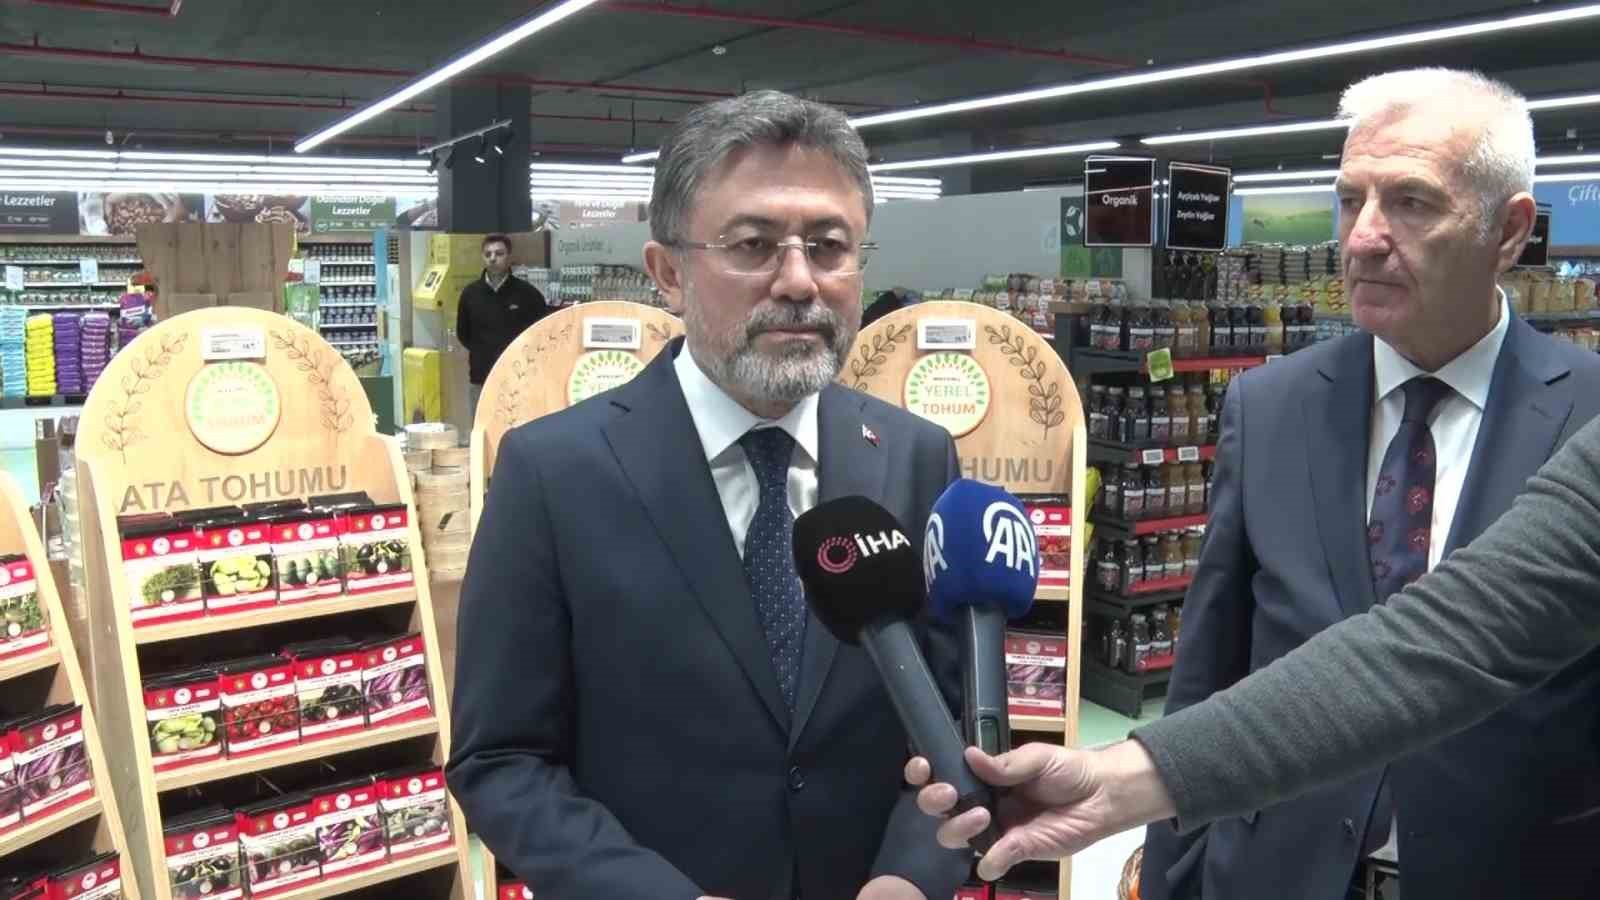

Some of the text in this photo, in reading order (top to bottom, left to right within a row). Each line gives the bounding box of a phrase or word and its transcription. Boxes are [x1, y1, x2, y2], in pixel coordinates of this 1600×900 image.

[4, 194, 57, 206] Lezzetler
[1102, 193, 1138, 207] Organik
[1567, 183, 1600, 206] Çift
[332, 205, 371, 216] Lezzetler
[924, 384, 973, 398] YEREL
[922, 402, 976, 415] TOHUM
[120, 465, 347, 512] ATA TOHUMU
[853, 529, 911, 557] İHA
[984, 516, 1035, 577] AA
